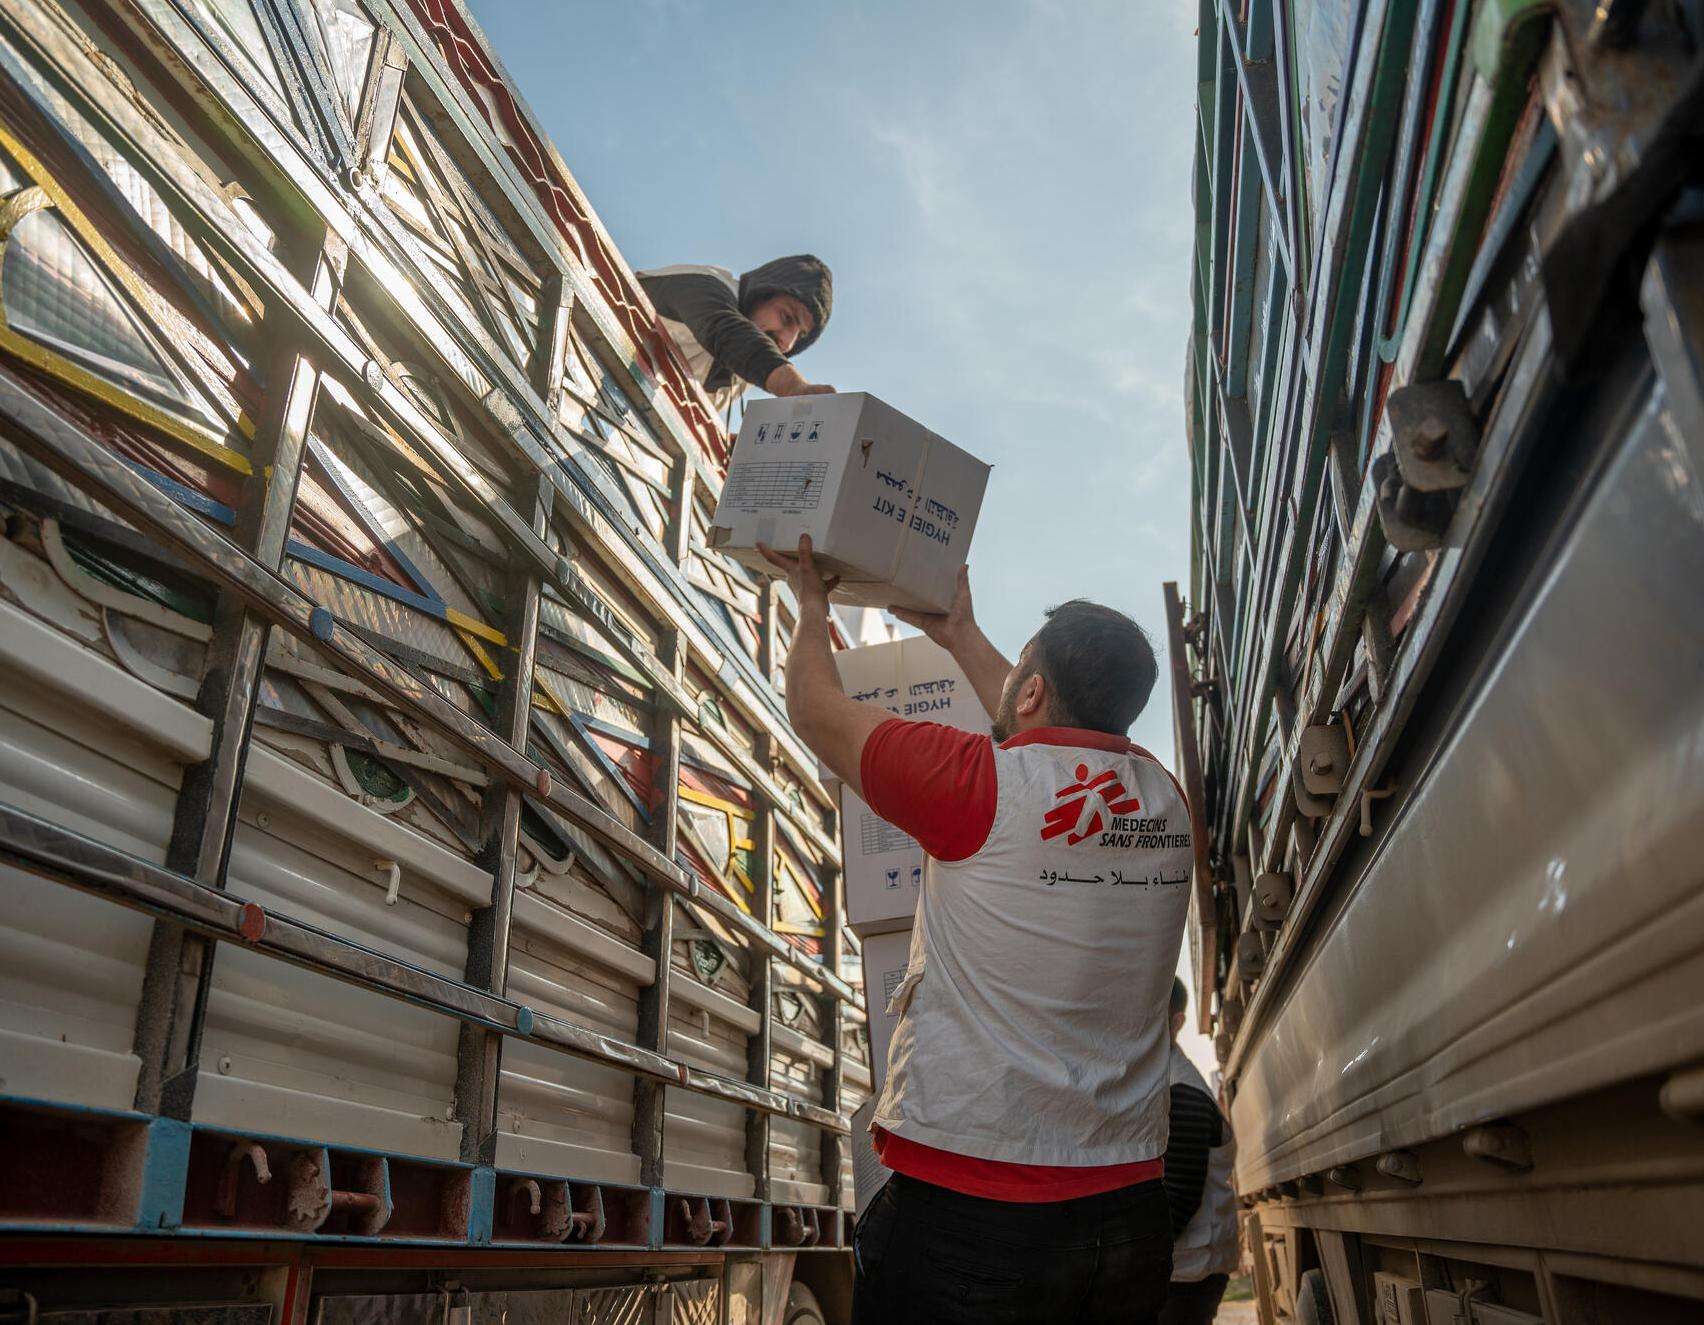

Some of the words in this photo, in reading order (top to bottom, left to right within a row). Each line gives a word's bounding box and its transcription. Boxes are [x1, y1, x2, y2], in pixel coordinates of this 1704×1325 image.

[872, 496, 896, 517] KIT
[909, 679, 955, 696] النظافة
[1110, 817, 1168, 832] MEDECINS
[1099, 833, 1134, 848] SANS
[1134, 833, 1191, 849] FRONTIERES
[1039, 869, 1105, 886] حدود
[1110, 870, 1149, 891] بلا
